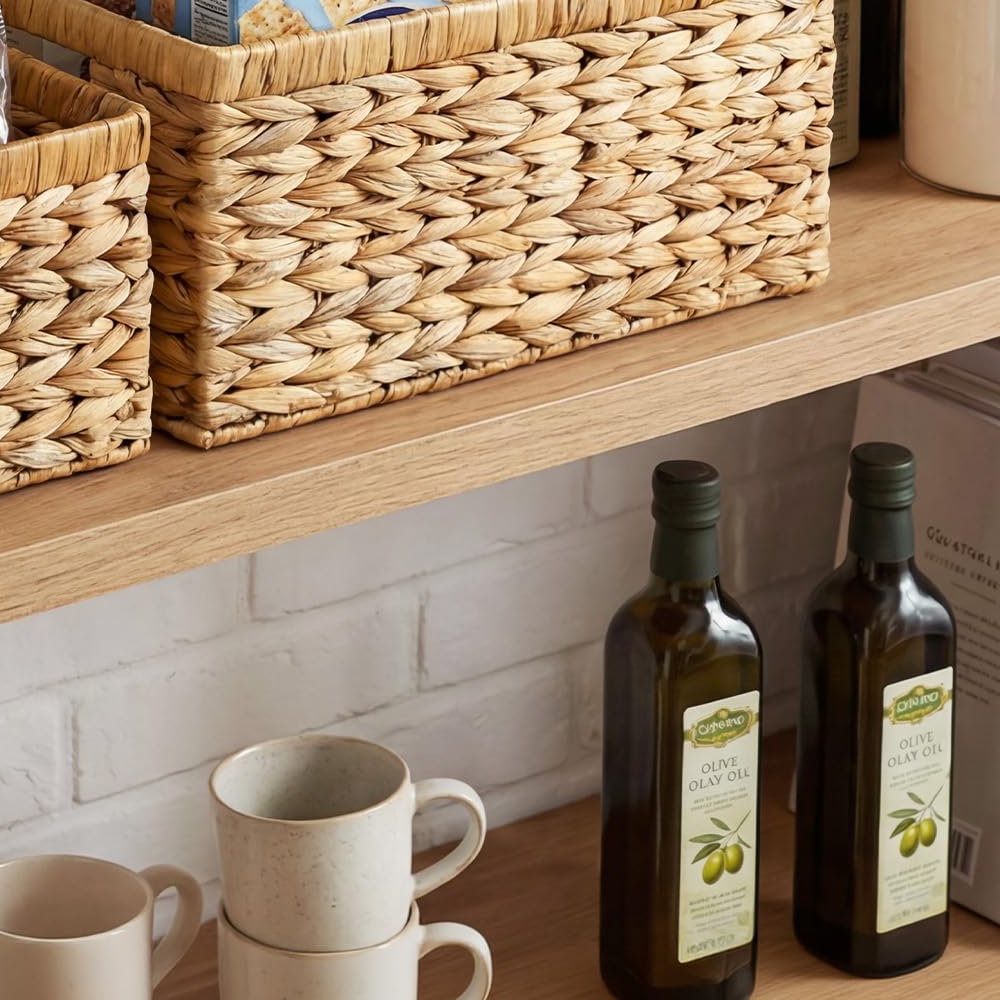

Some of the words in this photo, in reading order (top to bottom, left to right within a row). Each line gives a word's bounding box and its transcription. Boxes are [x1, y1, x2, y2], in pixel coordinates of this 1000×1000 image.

[899, 731, 934, 750] OLIVE
[701, 756, 739, 774] OLIVE
[688, 774, 723, 792] OLAY
